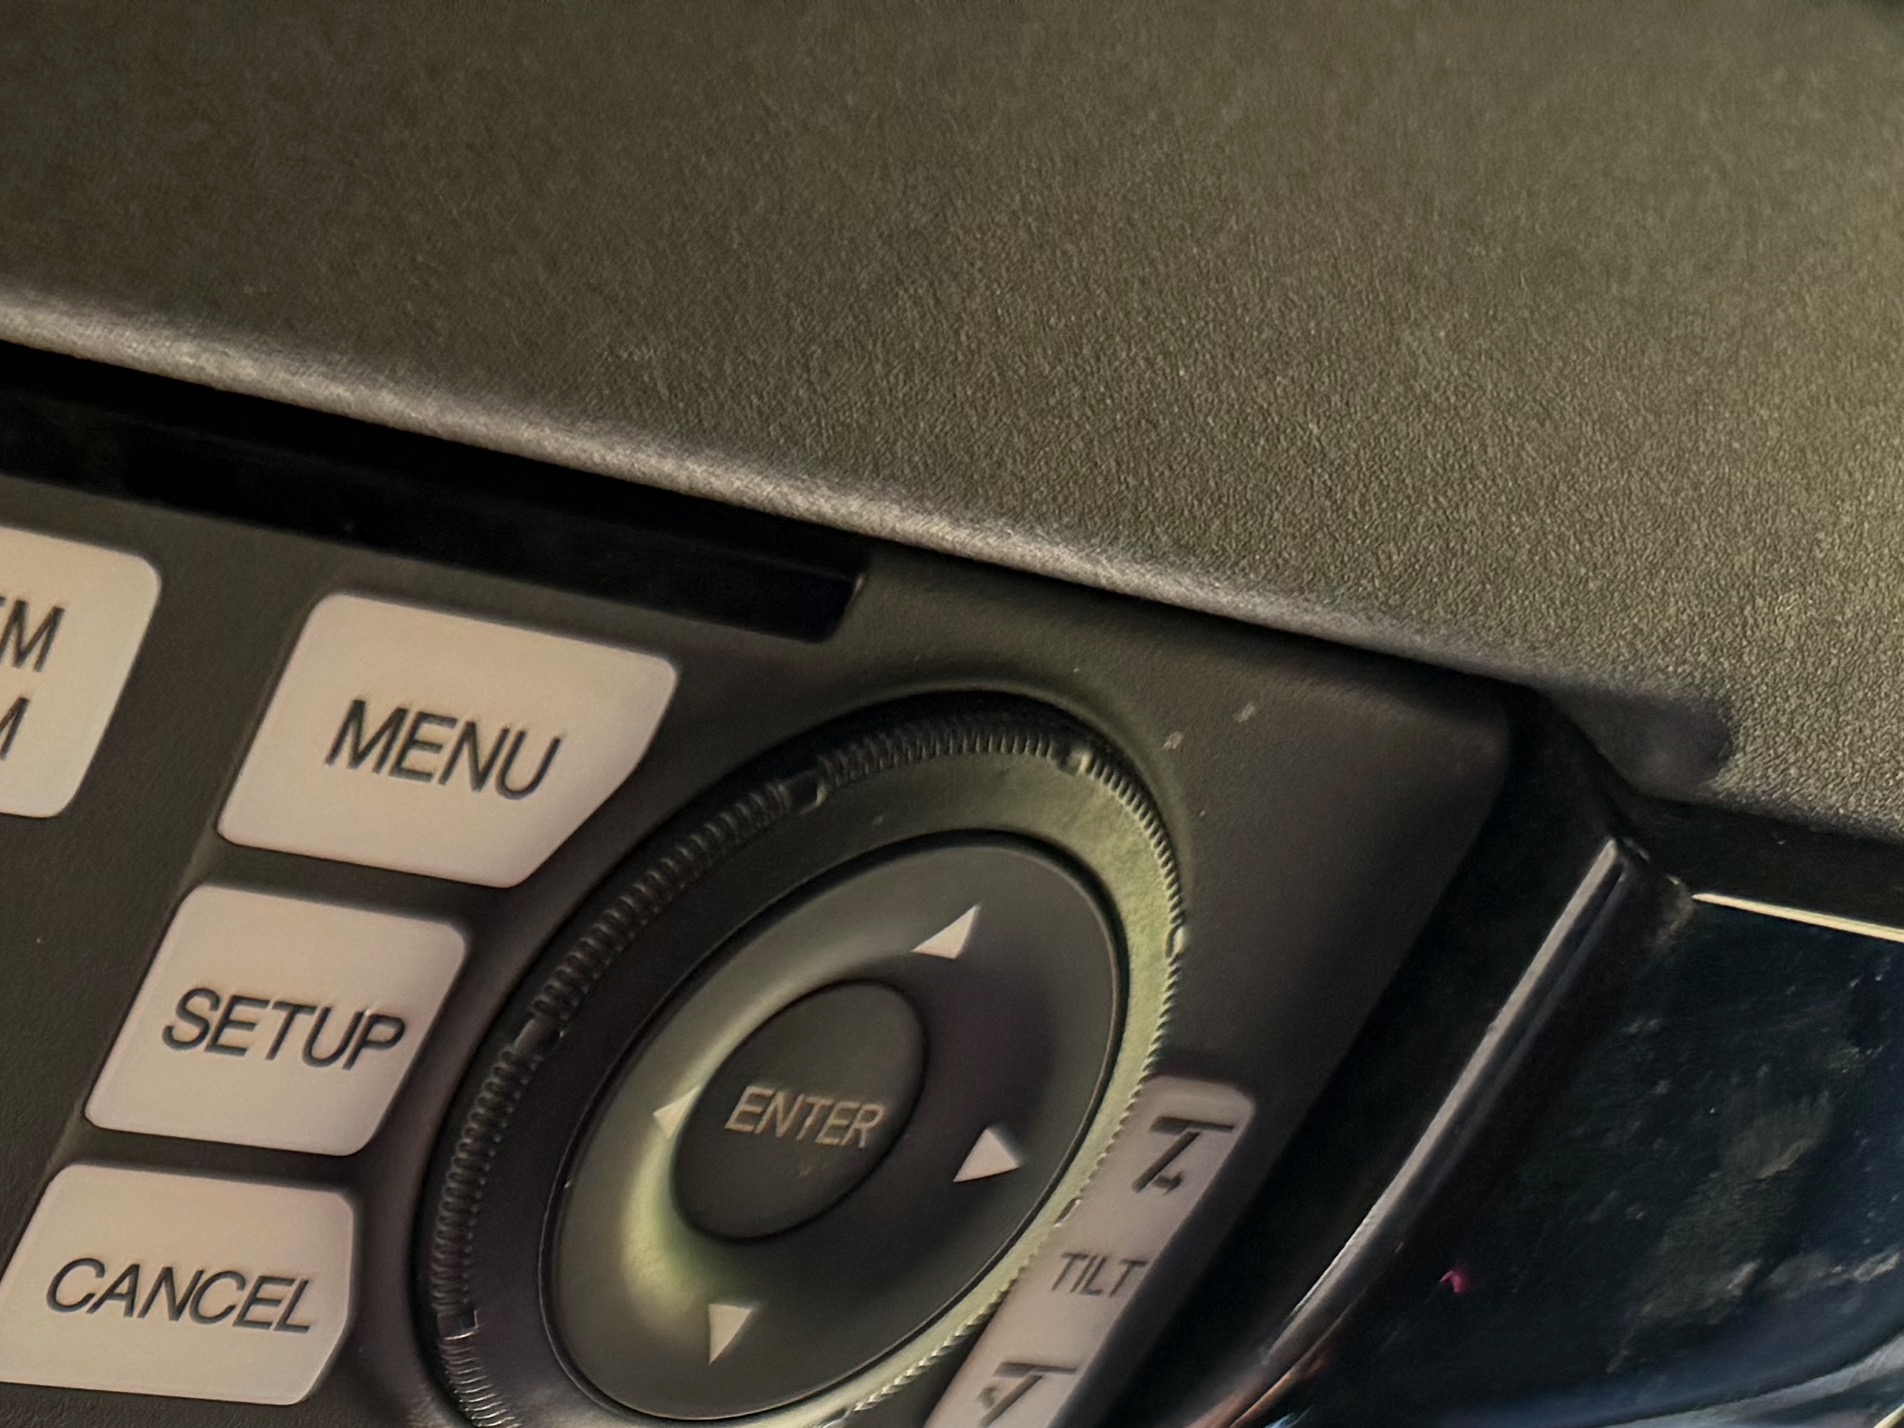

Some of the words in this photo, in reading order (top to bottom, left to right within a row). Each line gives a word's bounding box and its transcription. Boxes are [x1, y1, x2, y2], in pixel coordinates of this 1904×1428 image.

[323, 699, 564, 801] MENU
[160, 988, 408, 1073] SETUP
[723, 1088, 885, 1150] ENTER
[43, 1257, 314, 1338] CANCEL
[1050, 1252, 1150, 1299] TILT
